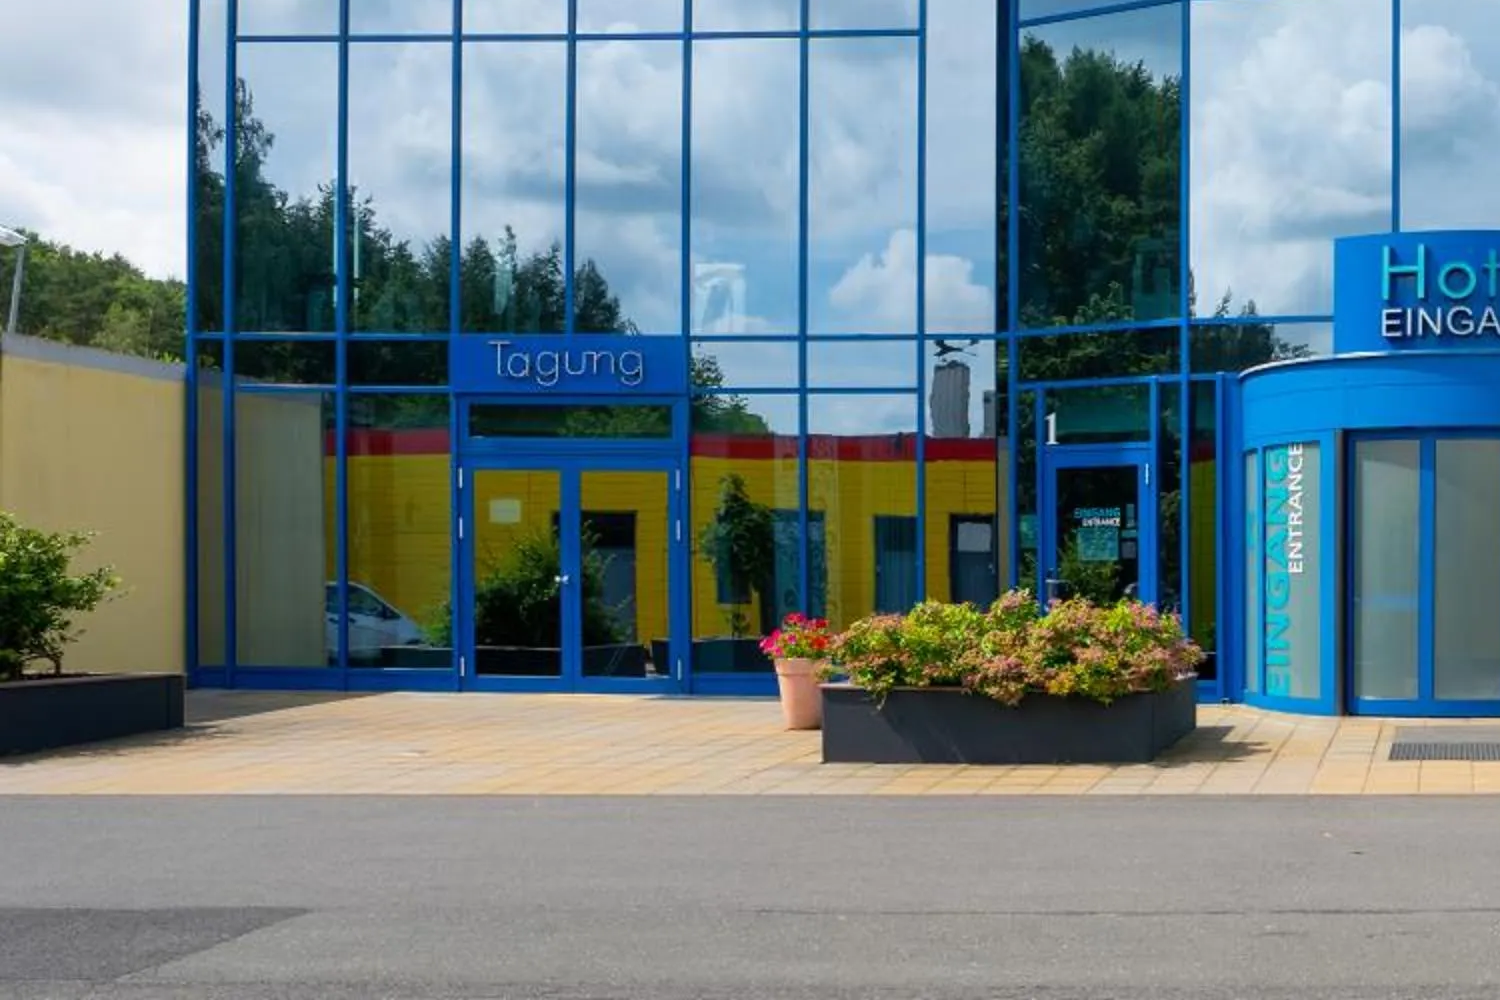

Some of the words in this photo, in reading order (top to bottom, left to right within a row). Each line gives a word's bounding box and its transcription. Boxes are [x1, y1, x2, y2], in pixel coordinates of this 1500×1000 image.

[488, 339, 644, 387] Tagung
[1045, 412, 1060, 444] 1
[1288, 442, 1304, 574] ENTRANCE
[1265, 446, 1290, 697] EINGANG
